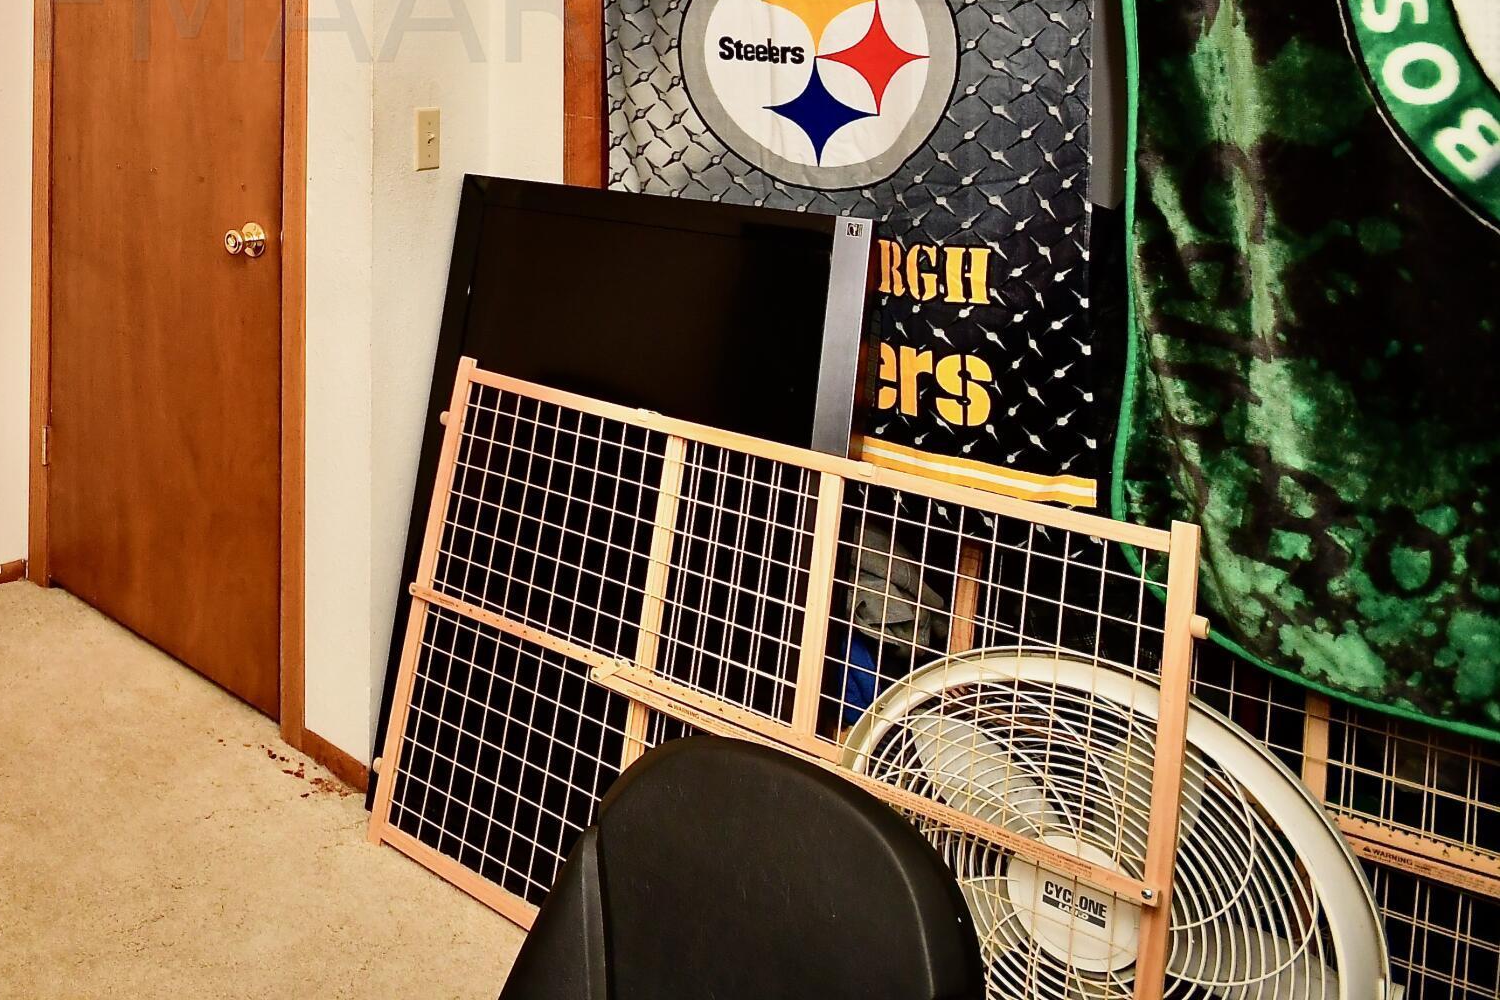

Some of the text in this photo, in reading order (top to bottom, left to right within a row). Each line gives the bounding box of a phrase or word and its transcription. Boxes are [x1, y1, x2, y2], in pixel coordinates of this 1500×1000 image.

[718, 36, 805, 65] Steelers
[878, 239, 992, 305] RGH
[1372, 848, 1413, 866] WARNING
[1045, 881, 1107, 919] CYCLONE
